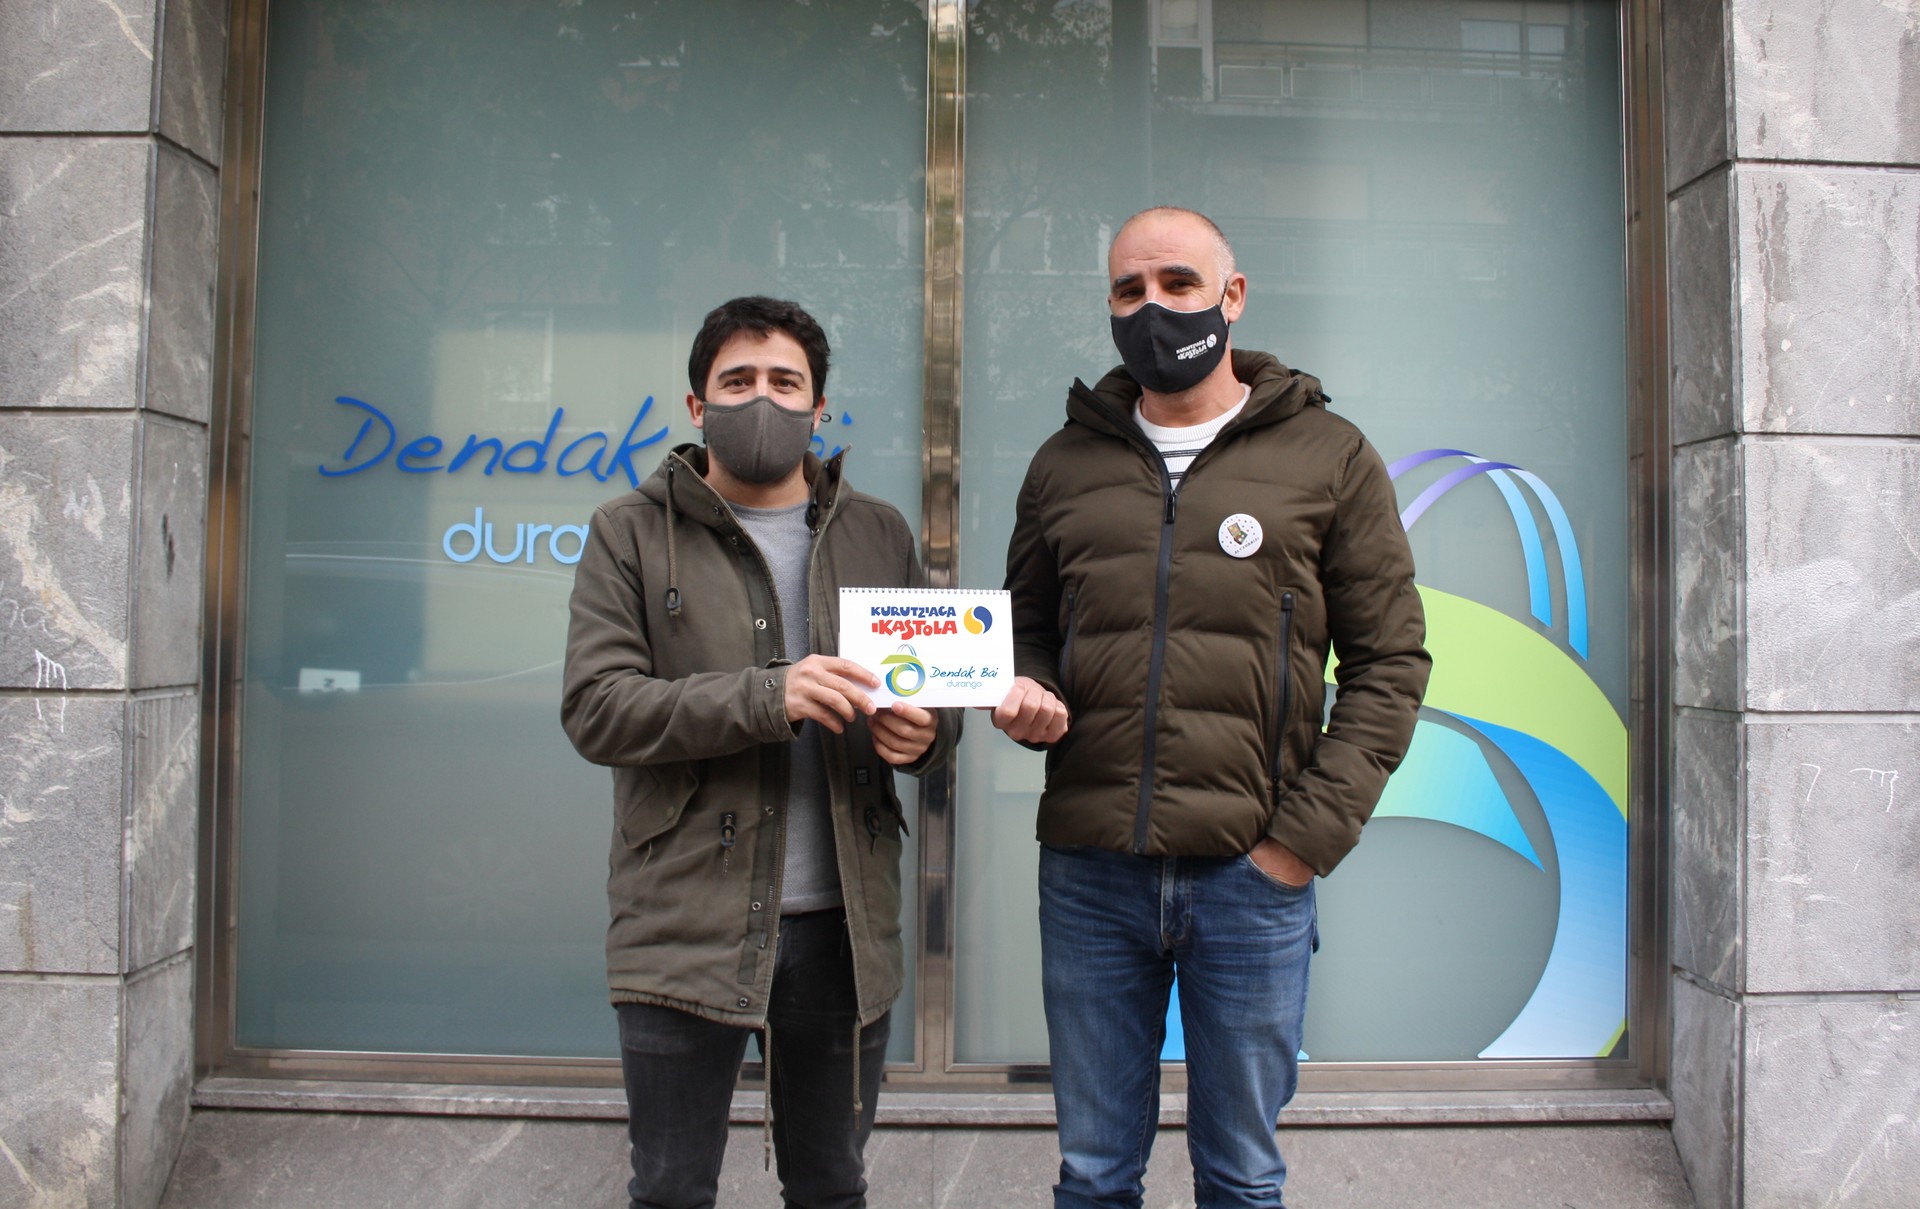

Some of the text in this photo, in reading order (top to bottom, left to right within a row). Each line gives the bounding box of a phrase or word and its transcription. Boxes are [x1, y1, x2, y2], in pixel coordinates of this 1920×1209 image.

[320, 396, 668, 487] Dendak
[443, 507, 591, 564] dura
[871, 619, 958, 640] IKASTOLA
[929, 665, 999, 679] Dendak Bai
[946, 680, 983, 690] durango
